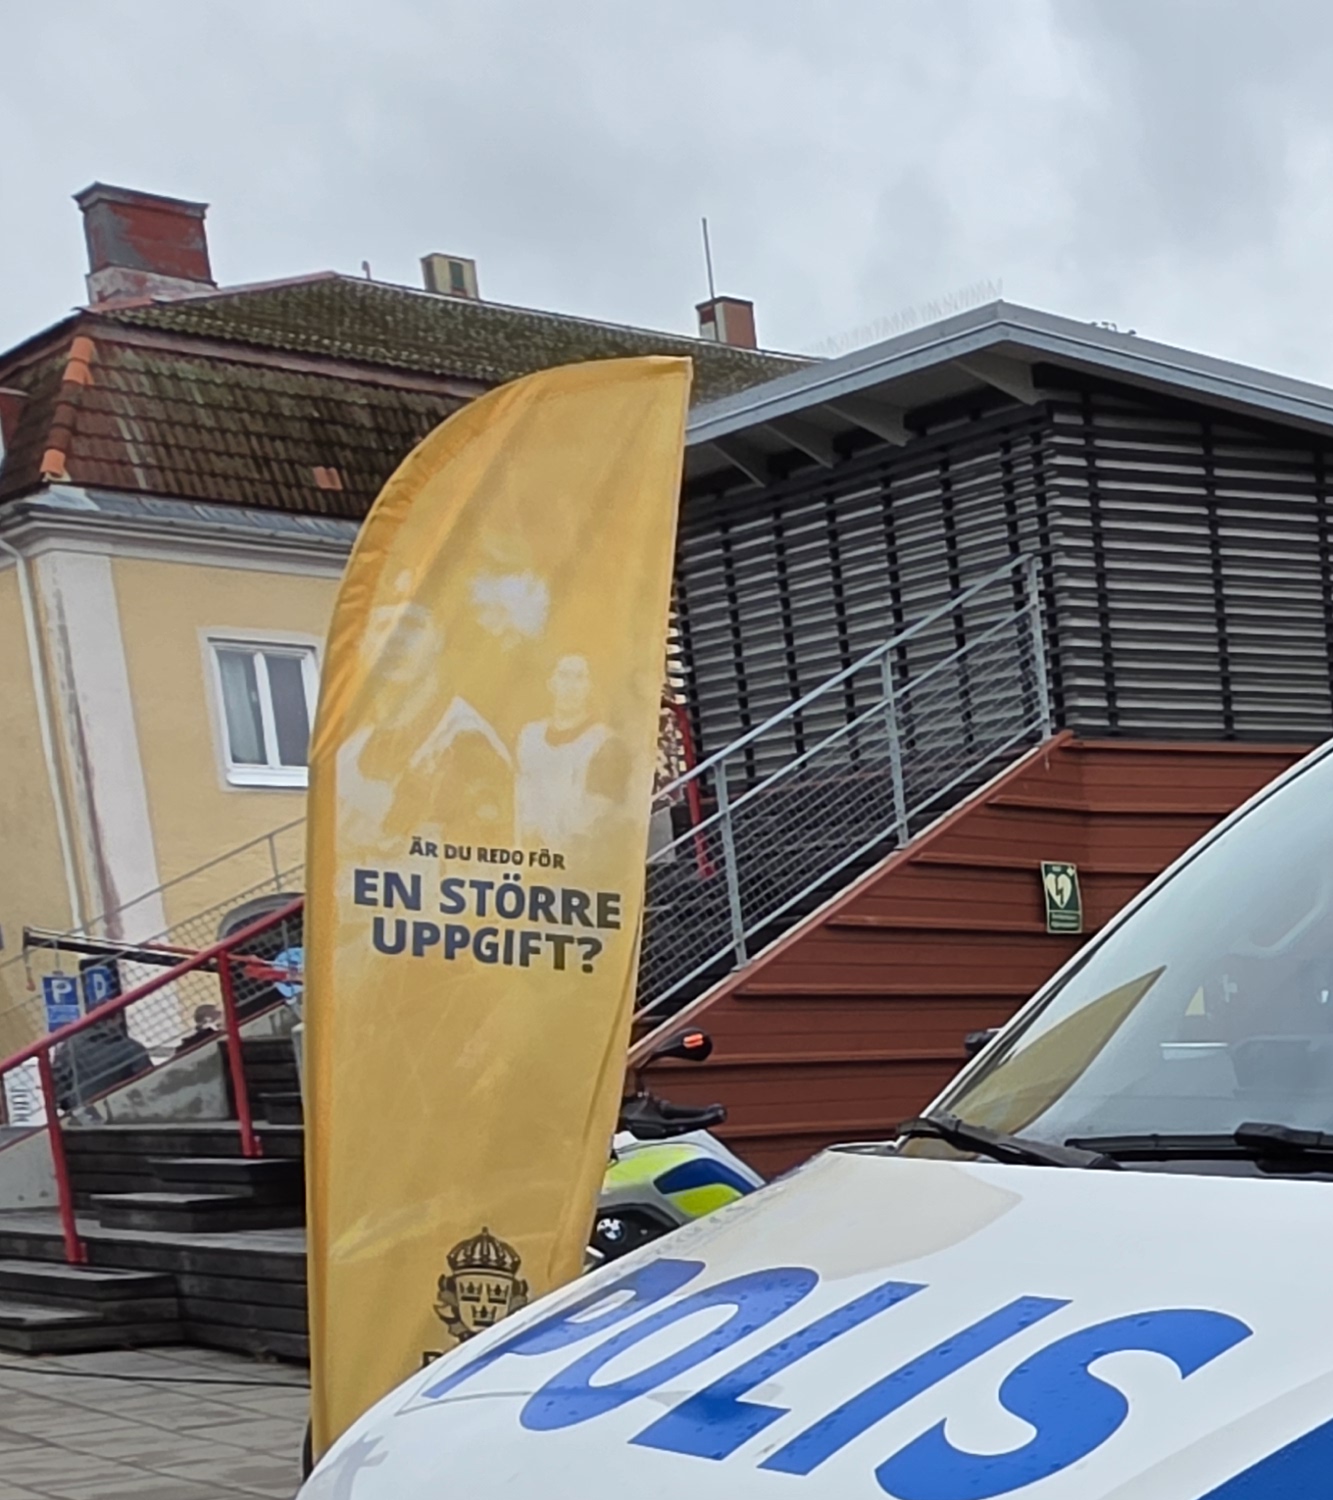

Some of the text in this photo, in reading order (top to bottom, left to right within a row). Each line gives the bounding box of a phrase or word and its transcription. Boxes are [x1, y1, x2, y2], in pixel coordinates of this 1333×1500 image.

[409, 836, 565, 869] ÄR DU REDO FÖR
[353, 869, 621, 930] EN STÖRRE
[372, 917, 602, 973] UPPGIFT?
[51, 979, 72, 1003] P
